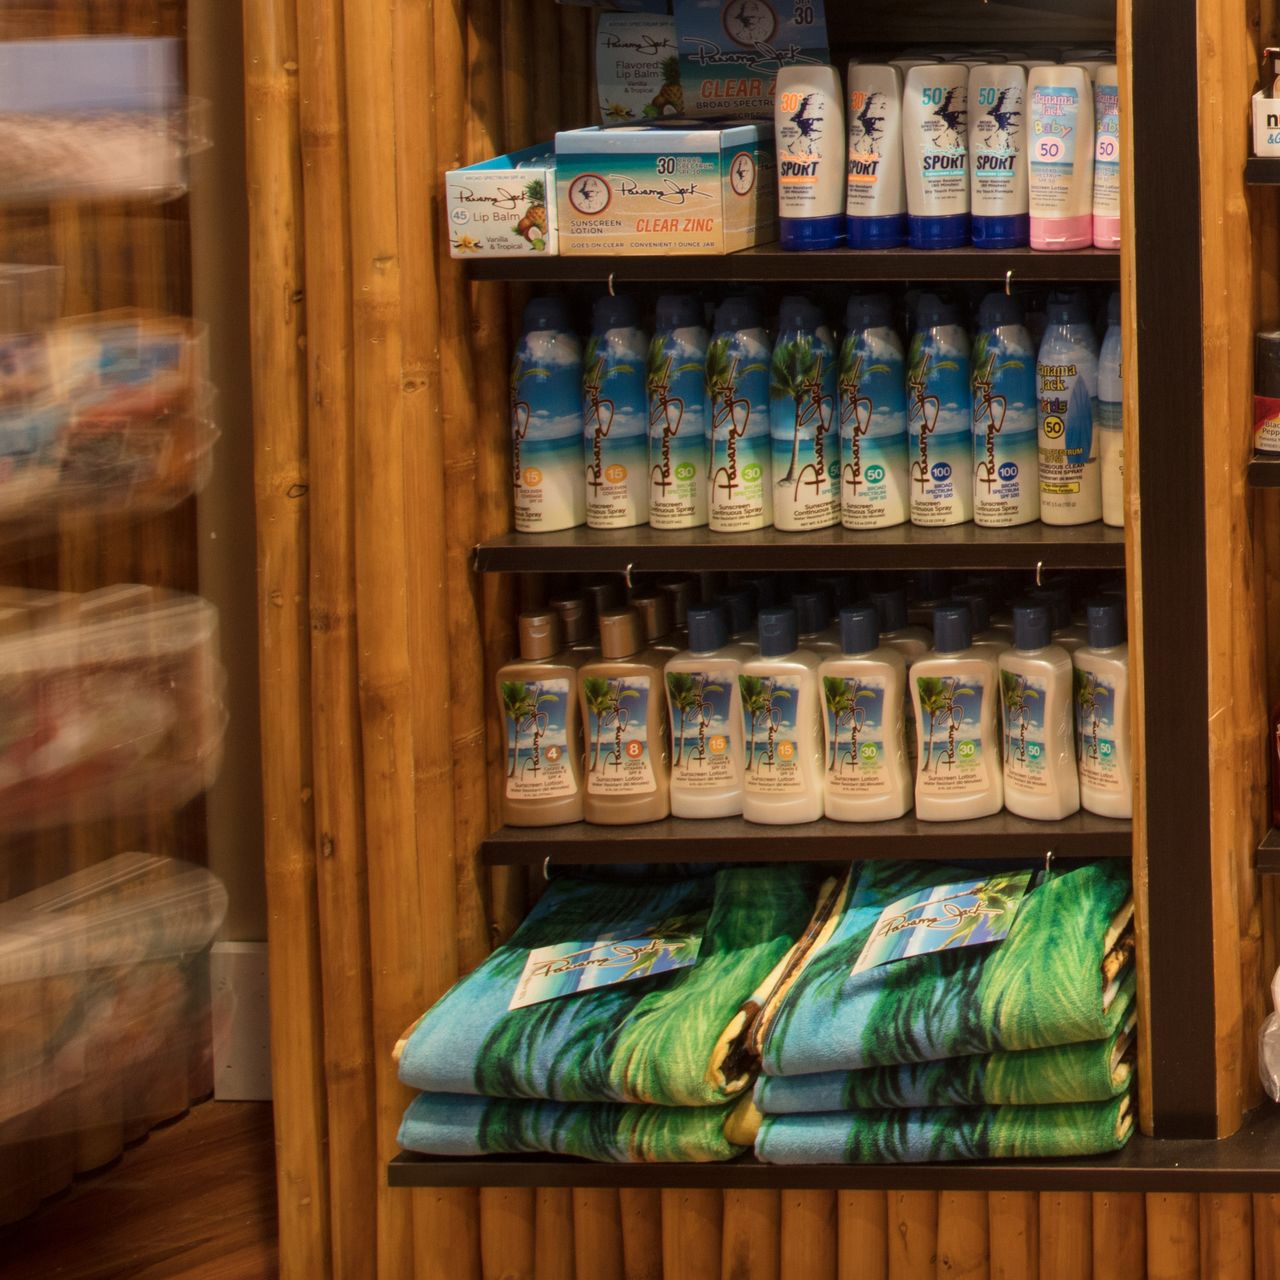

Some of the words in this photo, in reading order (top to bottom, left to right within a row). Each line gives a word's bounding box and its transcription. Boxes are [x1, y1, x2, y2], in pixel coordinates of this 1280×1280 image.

[1033, 120, 1072, 137] Baby
[1040, 143, 1059, 157] 50
[657, 158, 675, 174] 30
[924, 155, 964, 170] SPORT
[454, 211, 467, 221] 45
[473, 212, 489, 223] Lip
[493, 212, 520, 222] Balm
[636, 219, 680, 232] CLEAR
[683, 218, 714, 232] ZINC
[933, 467, 951, 478] 100
